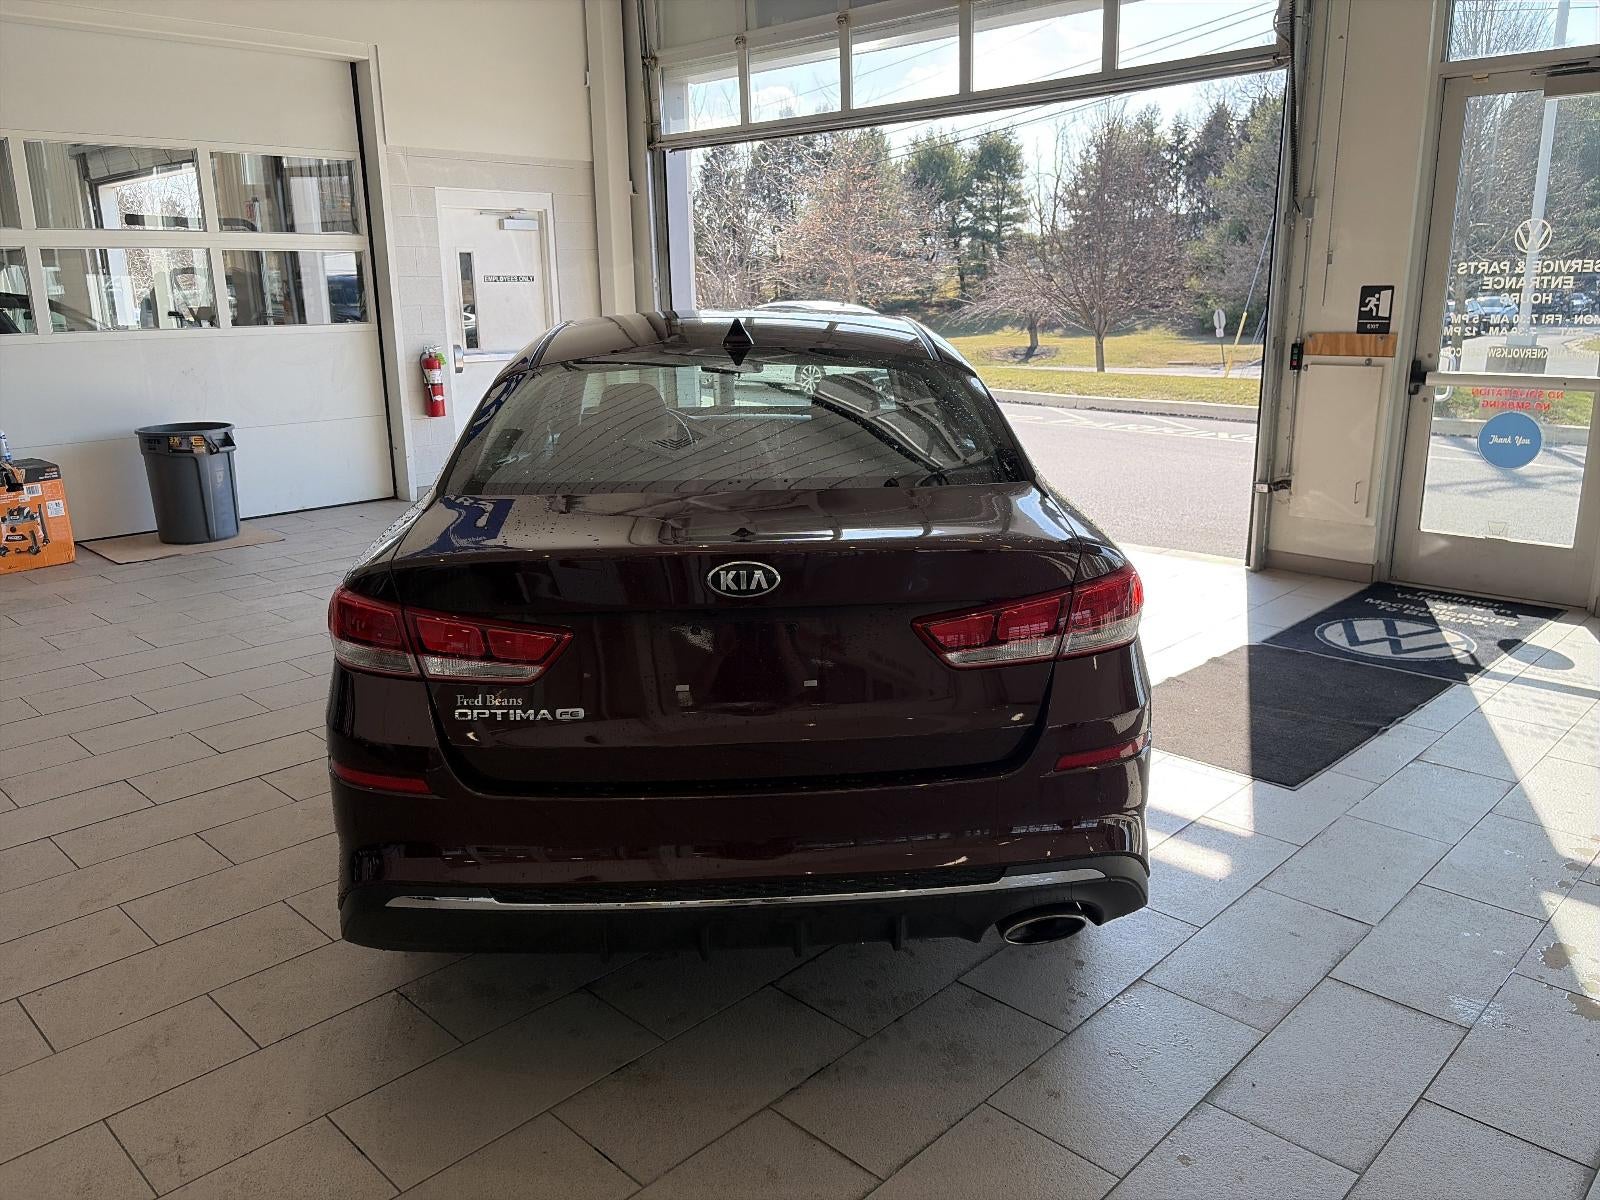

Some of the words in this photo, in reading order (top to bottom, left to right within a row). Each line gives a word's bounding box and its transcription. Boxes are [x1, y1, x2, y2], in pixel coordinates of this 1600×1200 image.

[1488, 434, 1512, 445] Thank
[1514, 435, 1531, 446] You
[719, 570, 769, 591] KIA
[456, 694, 483, 706] Fred
[486, 694, 523, 706] Beans
[454, 709, 554, 721] OPTIMA
